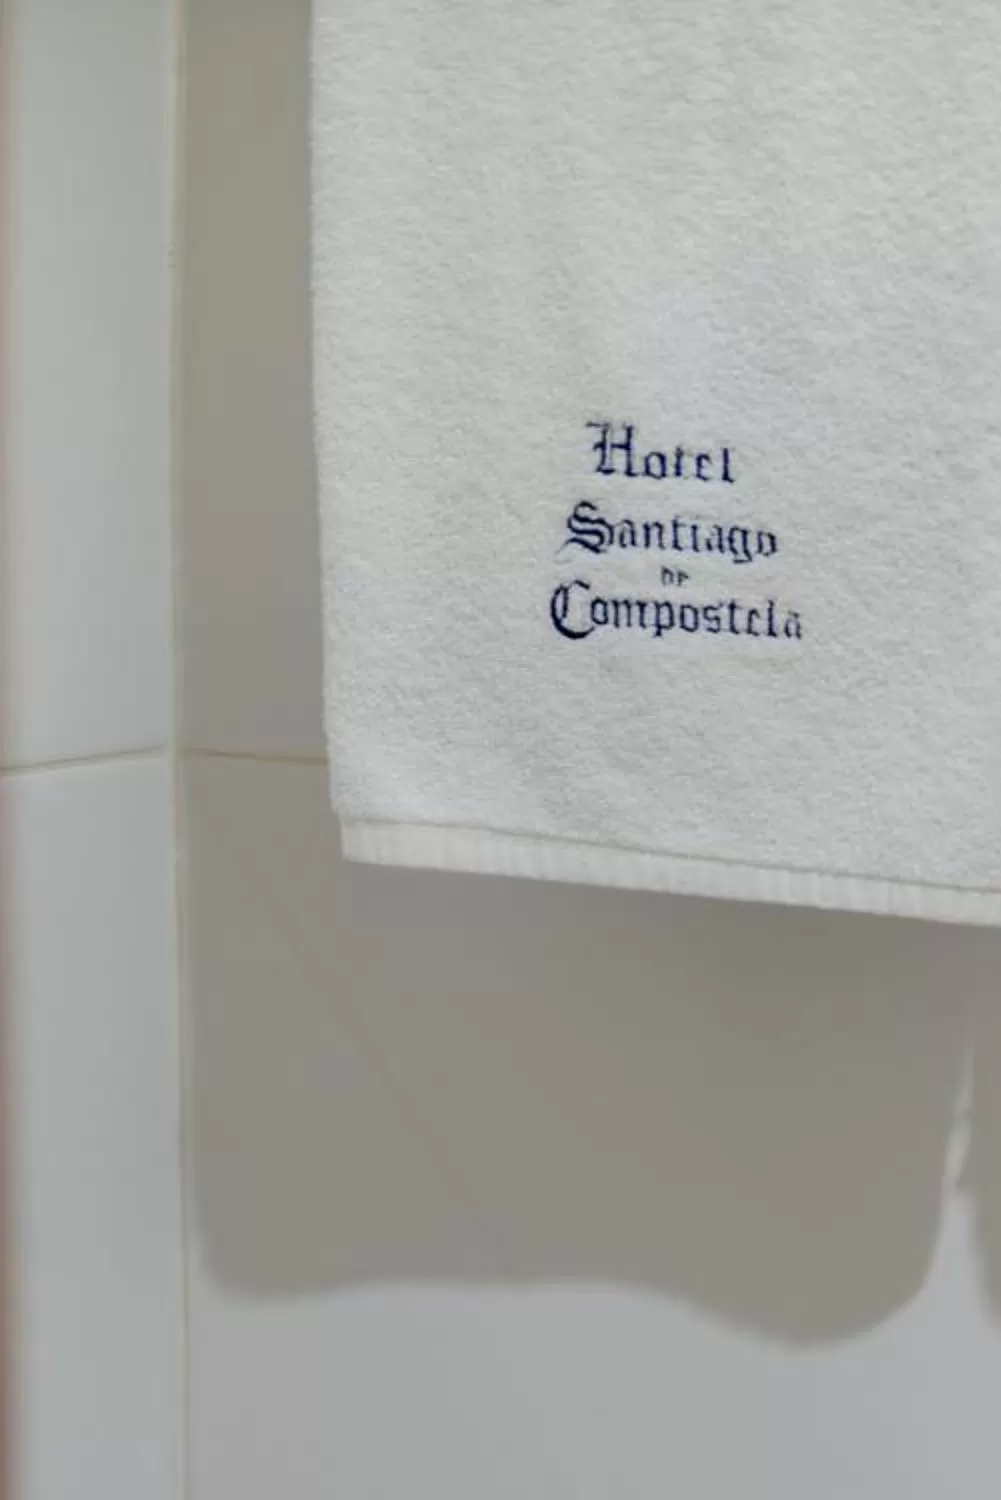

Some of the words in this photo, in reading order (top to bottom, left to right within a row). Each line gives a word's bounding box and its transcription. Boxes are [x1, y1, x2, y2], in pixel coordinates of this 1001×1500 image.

[585, 421, 735, 484] Hotel
[557, 500, 779, 564] Santiago
[550, 579, 803, 640] Compostela
